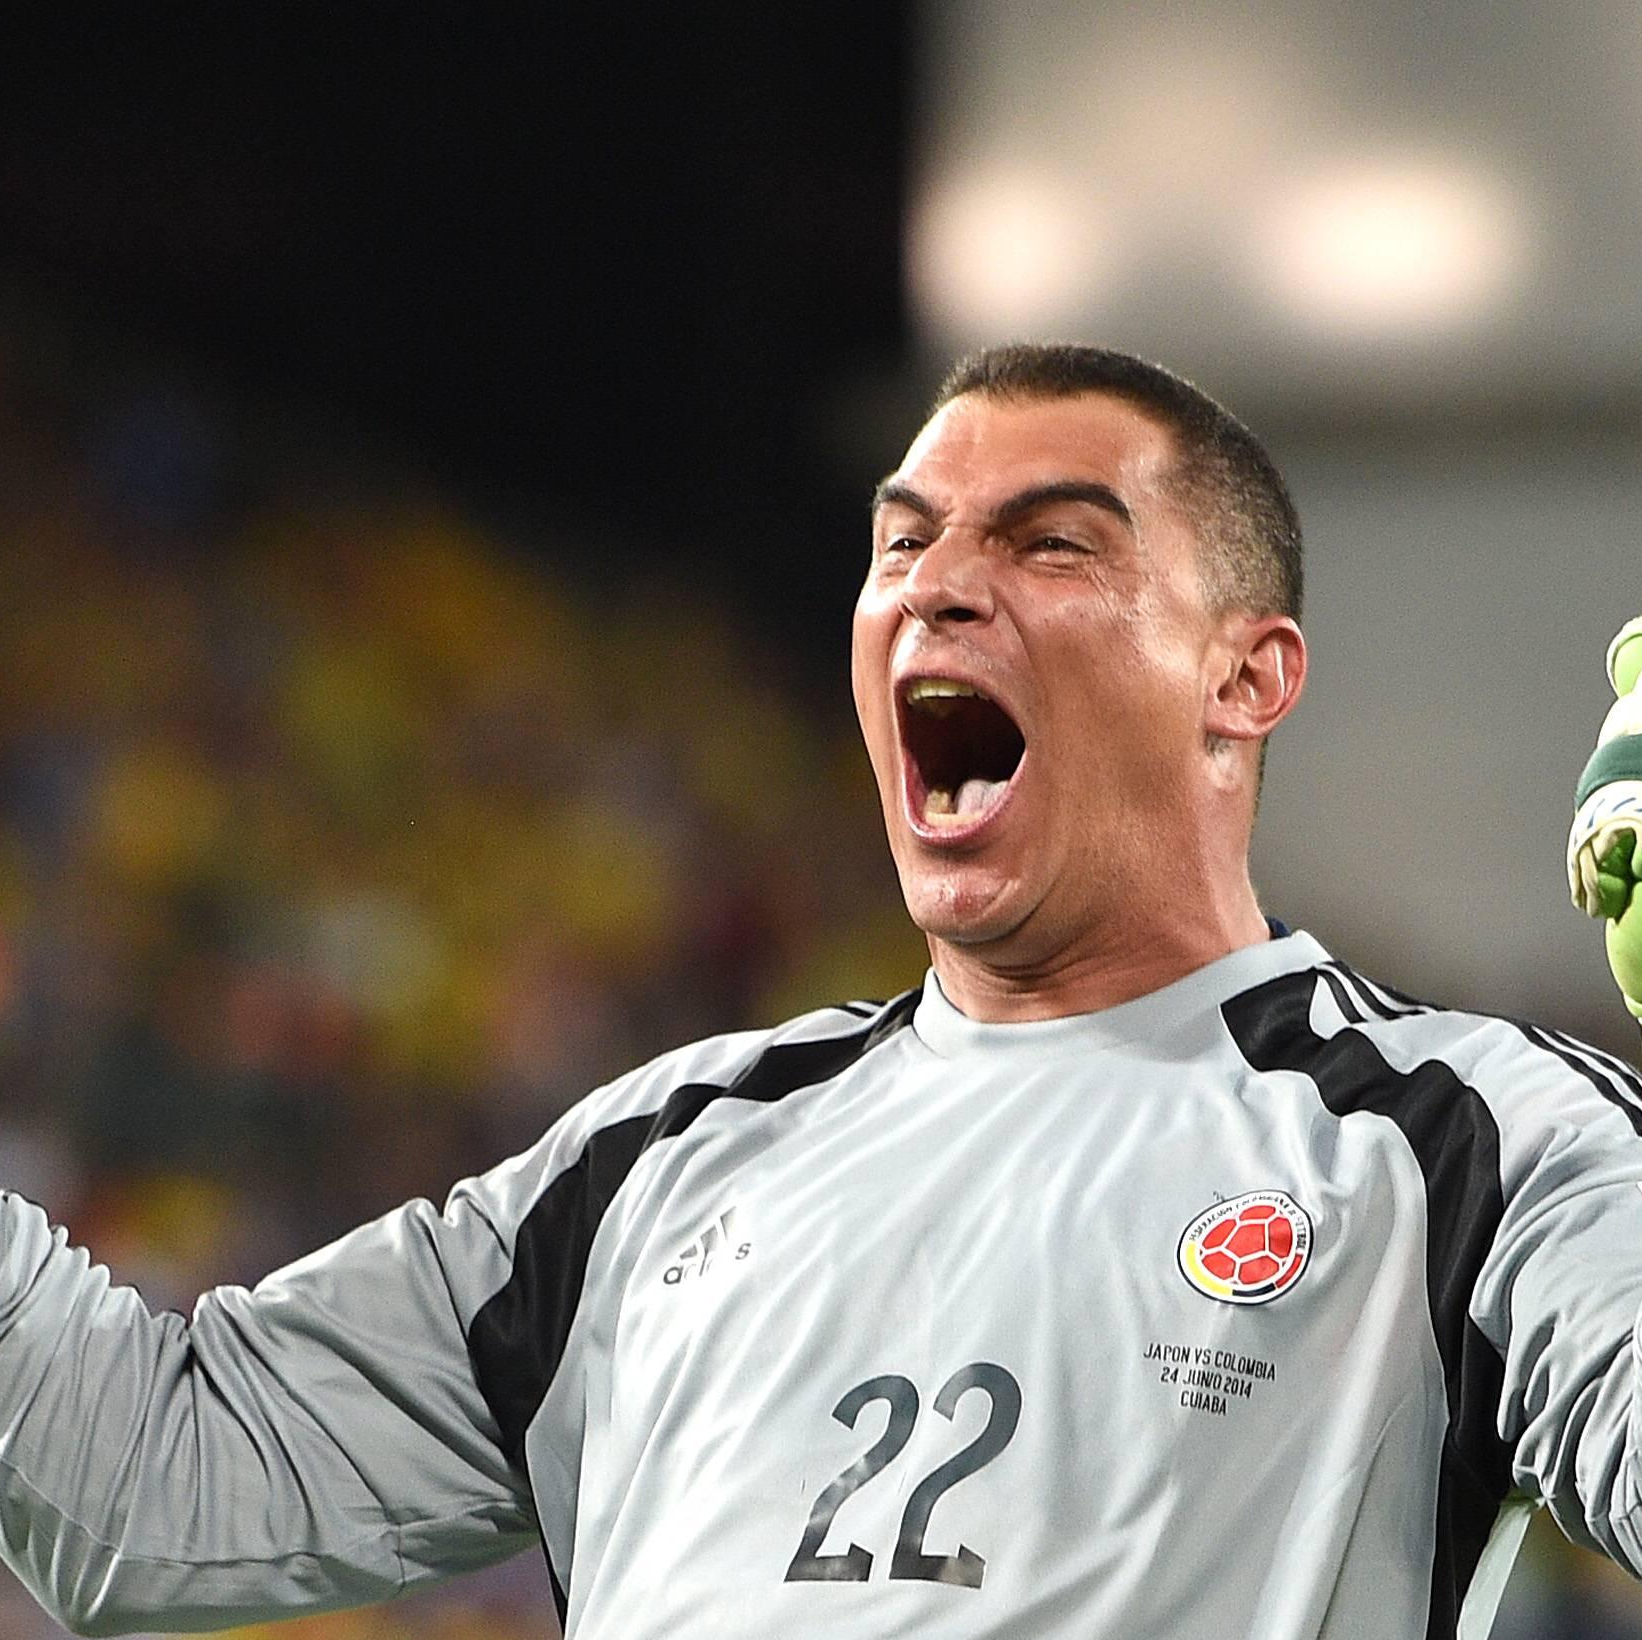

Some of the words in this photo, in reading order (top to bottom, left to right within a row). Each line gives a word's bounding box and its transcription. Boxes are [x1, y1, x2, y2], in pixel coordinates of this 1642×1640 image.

[1143, 1343, 1191, 1364] JAPON
[1194, 1347, 1212, 1366] VS
[1214, 1350, 1276, 1381] COLOMBIA
[1160, 1366, 1179, 1384] 24
[1182, 1369, 1222, 1390] JUNIO
[1223, 1376, 1253, 1399] 2014
[1180, 1390, 1227, 1416] CUIABA
[784, 1361, 1023, 1590] 22
